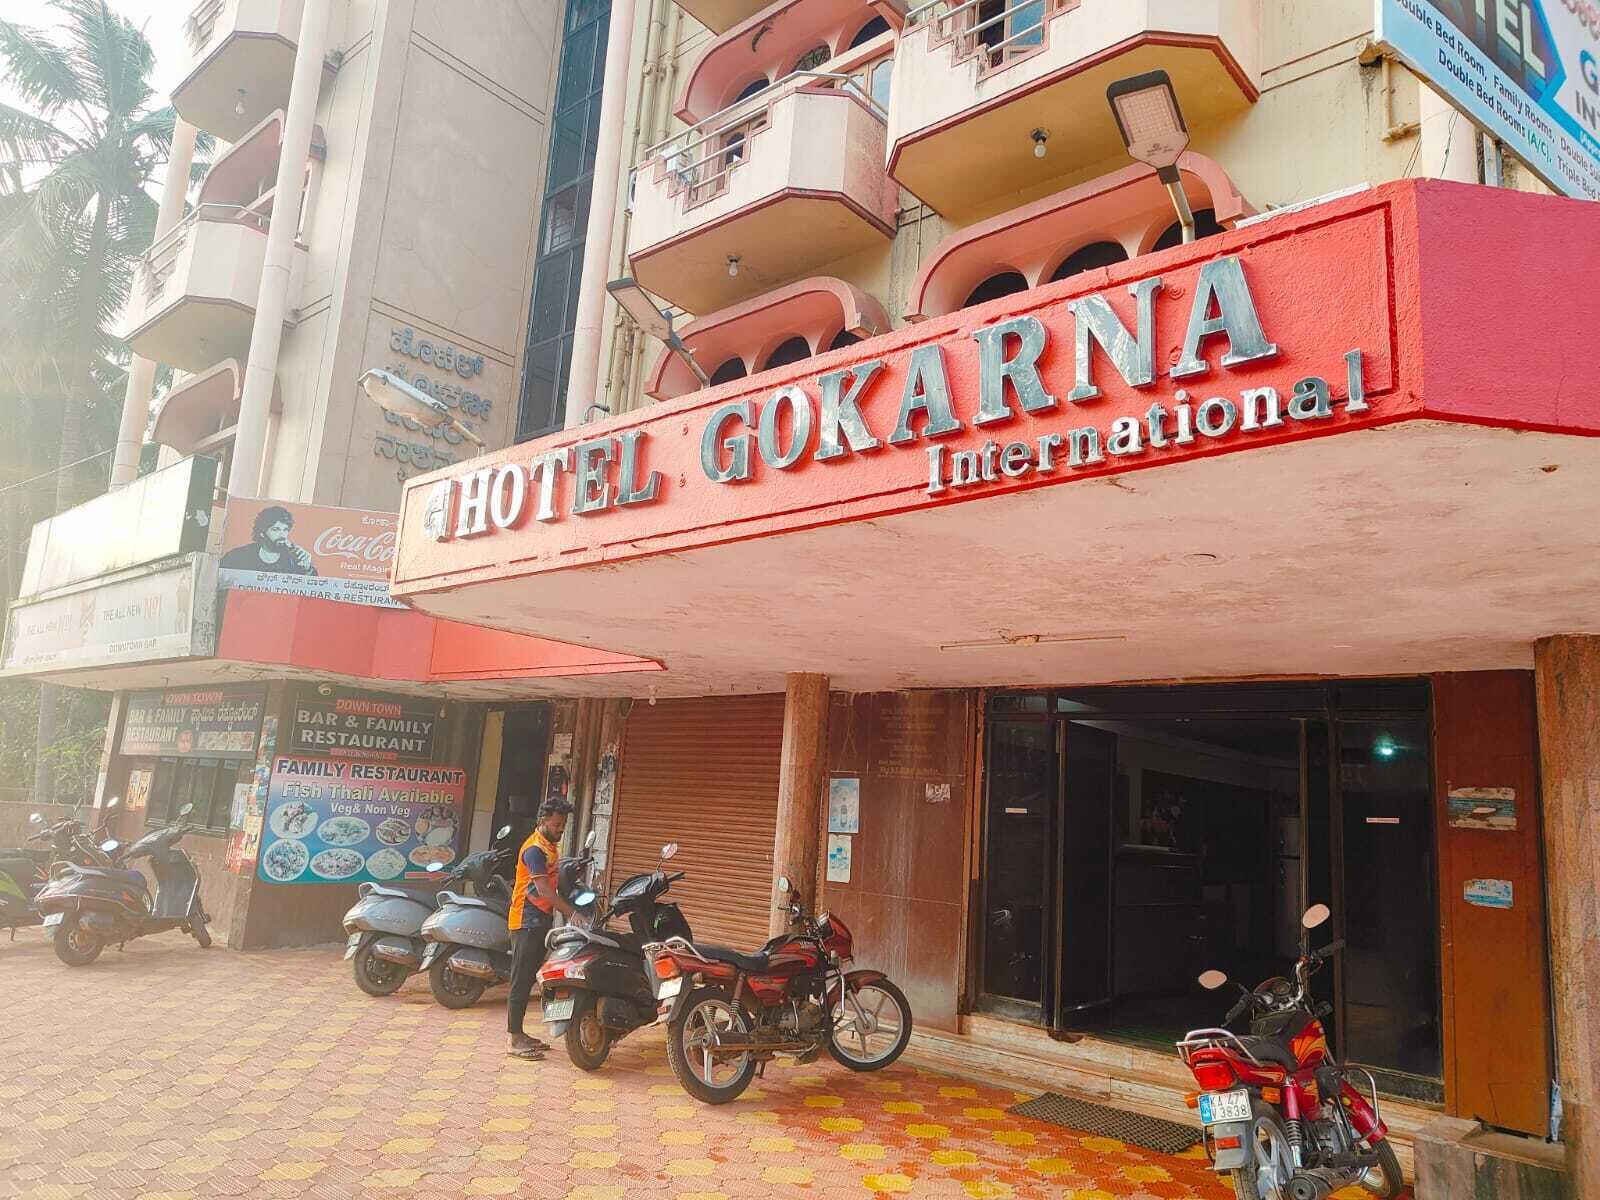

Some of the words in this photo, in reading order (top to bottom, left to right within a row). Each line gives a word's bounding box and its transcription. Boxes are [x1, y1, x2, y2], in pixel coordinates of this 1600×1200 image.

[1396, 0, 1433, 29] ouble
[1435, 20, 1455, 50] Bed
[1494, 74, 1523, 114] Family
[1560, 137, 1588, 171] Double
[1438, 48, 1475, 92] Double
[1476, 82, 1495, 110] Bed
[1496, 100, 1526, 137] Rooms
[1557, 154, 1581, 186] Triple
[1575, 89, 1600, 130] IN
[454, 430, 662, 538] HOTEL
[700, 256, 1279, 483] GOKARNA
[925, 348, 1370, 495] International
[309, 590, 331, 600] BAR
[334, 592, 342, 601] &
[128, 709, 145, 724] BAR
[155, 708, 186, 723] FAMILY
[336, 699, 370, 713] DOWN
[371, 702, 400, 714] TOWN
[125, 726, 178, 743] RESTAURANT
[297, 710, 338, 726] BAR
[344, 715, 360, 729] &
[366, 716, 432, 735] FAMILY
[301, 729, 426, 752] RESTAURANT
[277, 759, 346, 778] FAMILY
[351, 764, 464, 785] RESTAURANT
[280, 782, 321, 799] Fish
[330, 784, 374, 801] Thali
[378, 788, 454, 805] Available
[330, 802, 361, 816] Veg&
[365, 803, 387, 815] Non
[390, 804, 411, 817] Veg
